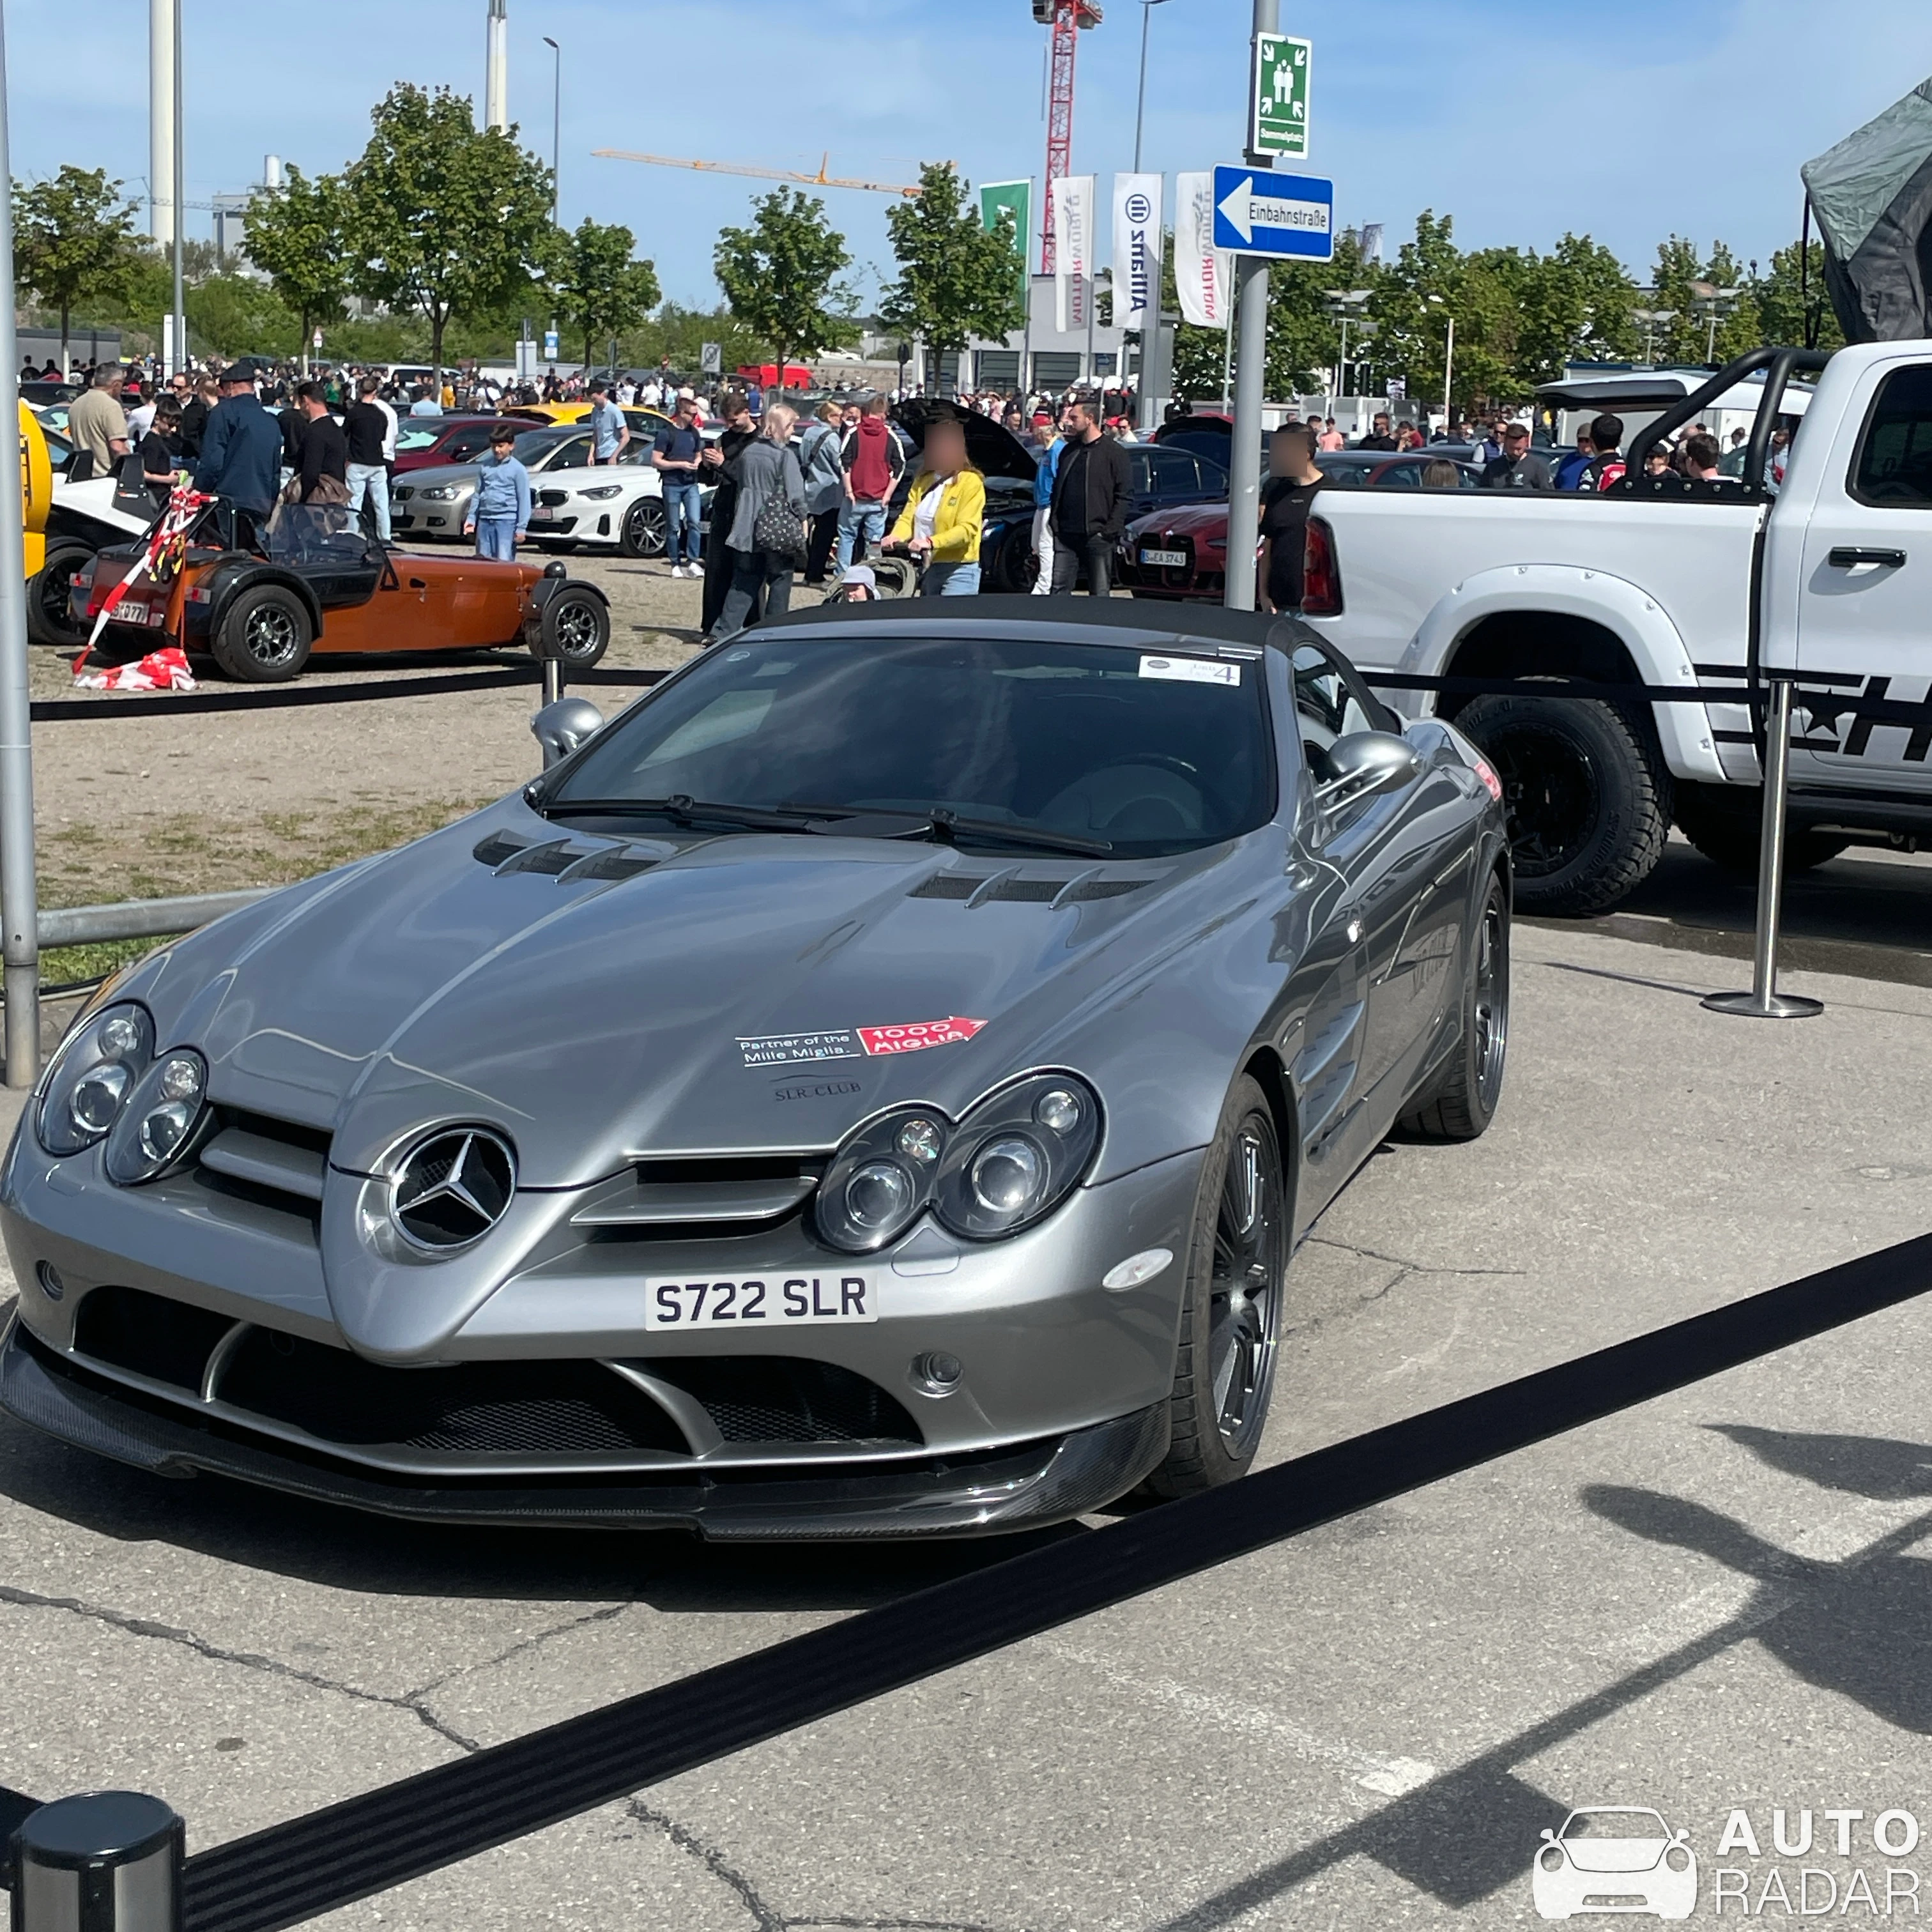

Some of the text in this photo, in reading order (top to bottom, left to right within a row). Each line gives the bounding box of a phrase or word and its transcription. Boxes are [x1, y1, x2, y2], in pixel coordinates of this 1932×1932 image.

[1249, 202, 1326, 227] Einbahnstraße
[1213, 666, 1236, 682] 4
[872, 1023, 951, 1039] 1000
[740, 1035, 850, 1051] Partner of the
[873, 1031, 963, 1052] MIGLIA
[744, 1052, 787, 1062] Mille
[775, 1082, 861, 1101] SLR CLUB
[656, 1277, 866, 1322] S722 SLR
